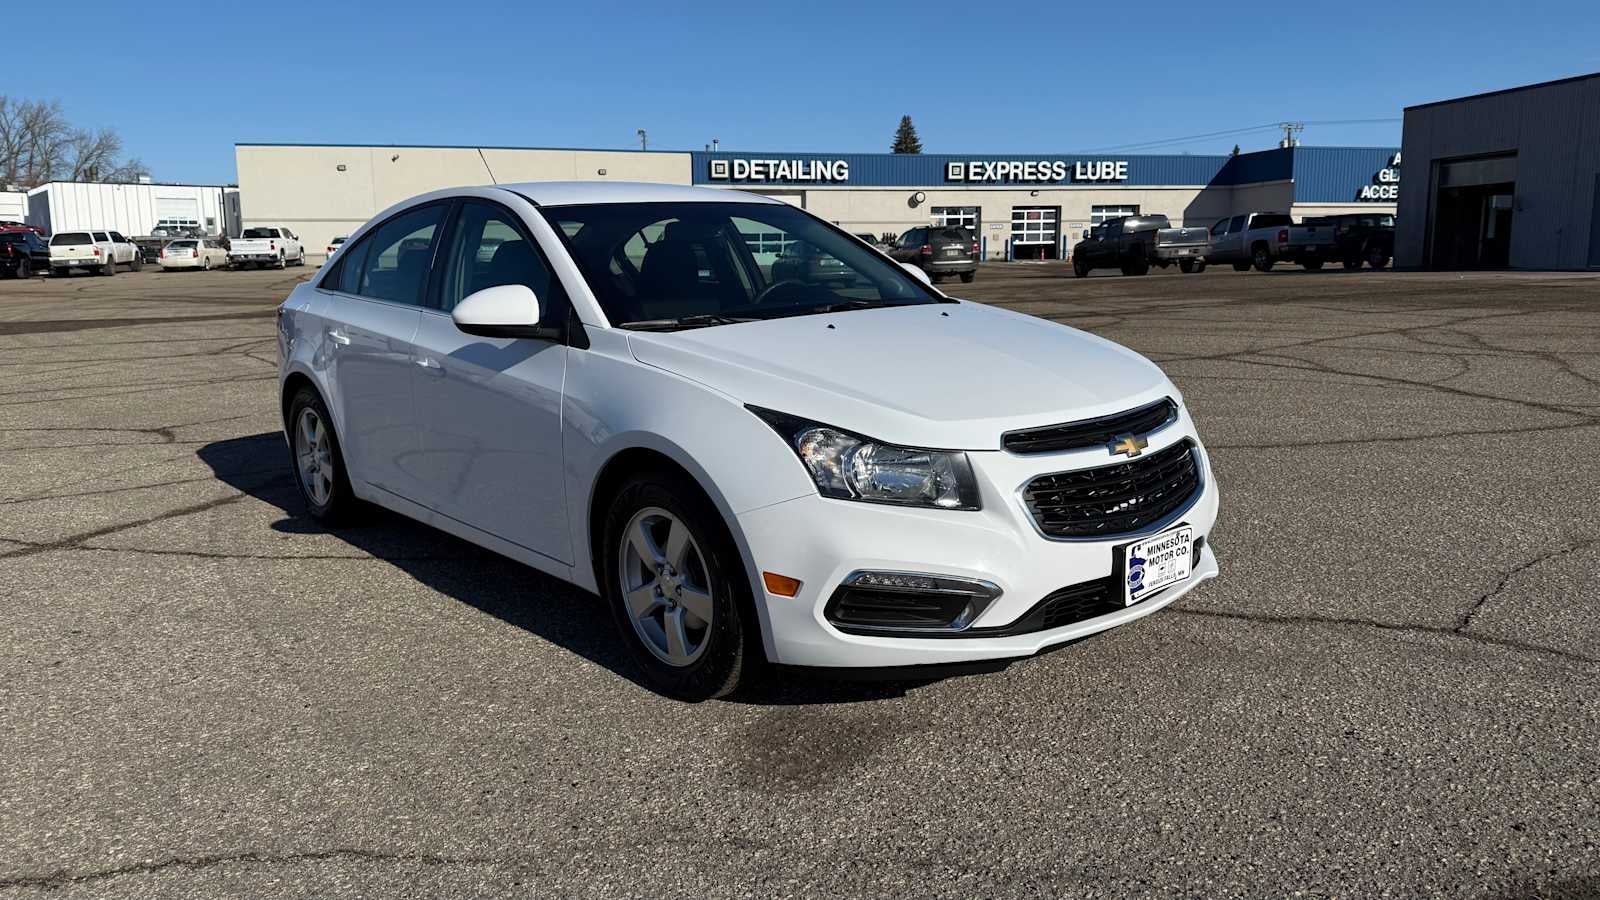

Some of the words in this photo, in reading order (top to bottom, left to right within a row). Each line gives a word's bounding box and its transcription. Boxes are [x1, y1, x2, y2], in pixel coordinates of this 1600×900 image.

[733, 160, 849, 180] DETAILING
[969, 161, 1066, 181] EXPRESS
[1075, 161, 1128, 180] LUBE
[1379, 168, 1401, 182] GL
[1147, 534, 1190, 556] MINNESOTA
[1149, 550, 1174, 567] MOTOR
[1176, 546, 1190, 557] CO.
